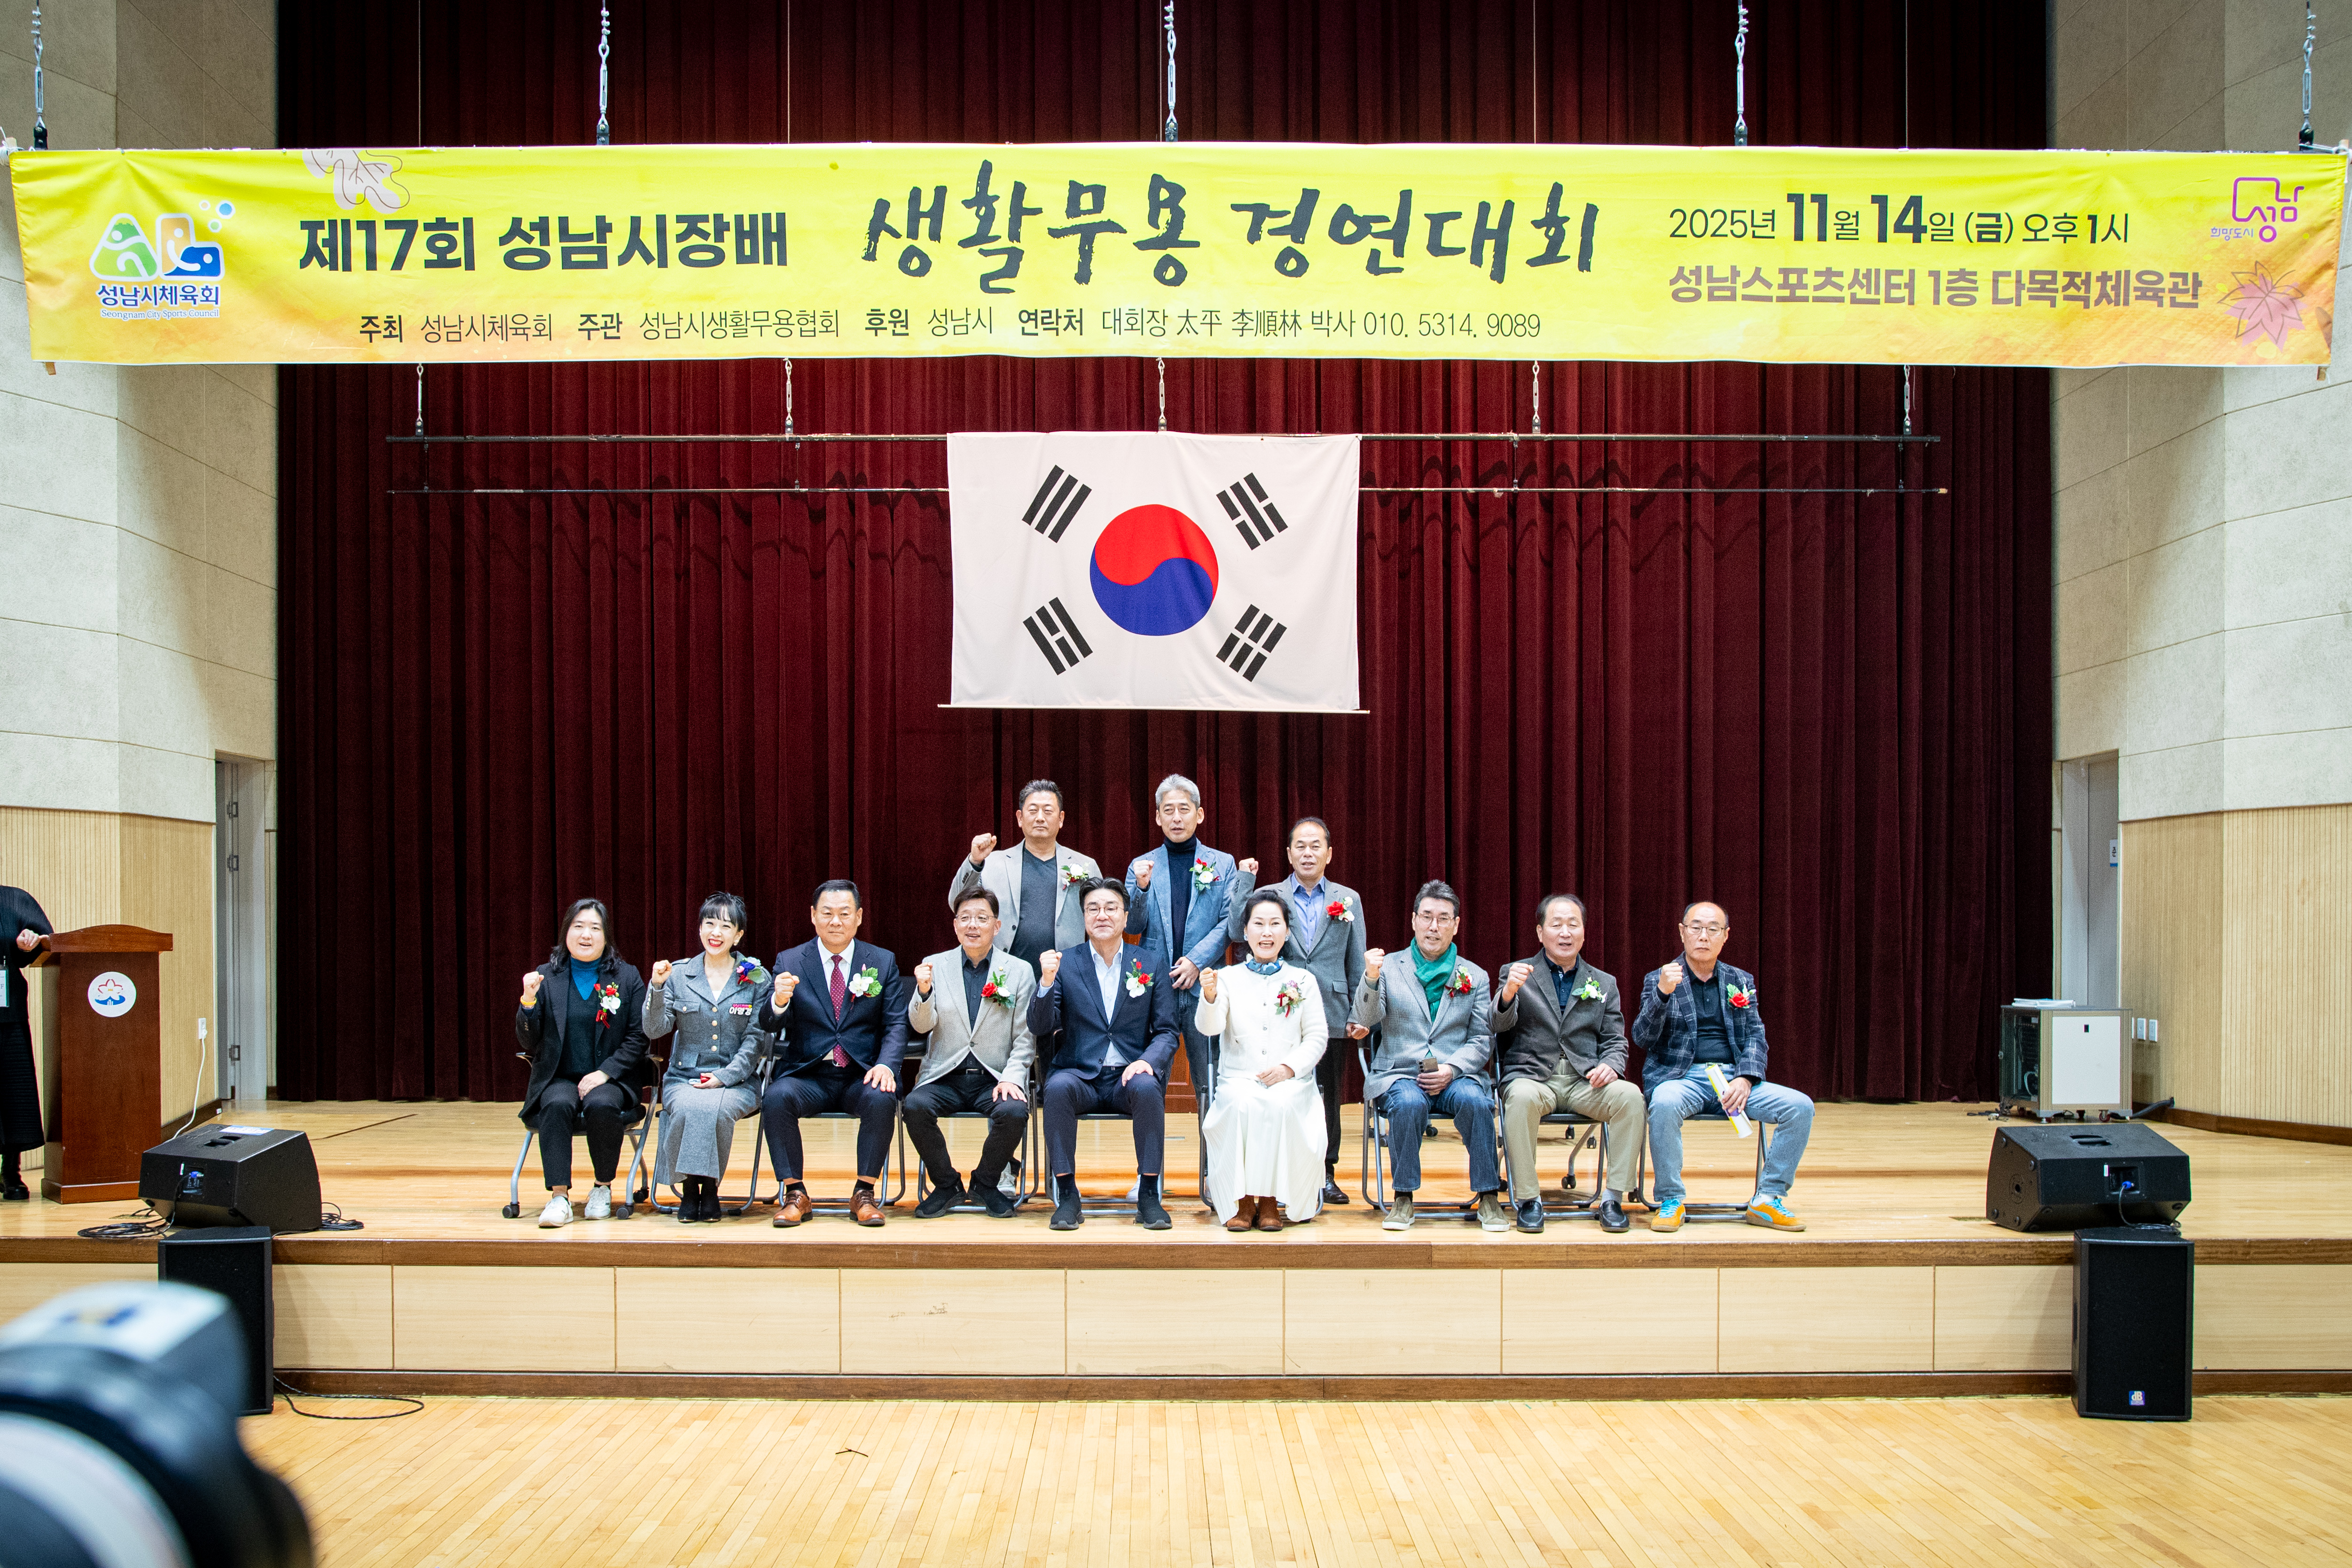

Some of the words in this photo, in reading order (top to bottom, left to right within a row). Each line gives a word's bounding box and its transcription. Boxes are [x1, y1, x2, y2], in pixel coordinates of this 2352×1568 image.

[300, 218, 475, 272] 제17회
[499, 213, 787, 270] 성남시장배
[862, 160, 1200, 294] 생활무용
[1231, 182, 1599, 284] 경연대회
[1670, 209, 1775, 239] 2025년
[1787, 193, 1859, 242] 11월
[1871, 195, 1953, 243] 14일
[1965, 212, 2013, 243] (금)
[2023, 213, 2078, 243] 오후
[2087, 213, 2128, 243] 1시
[2211, 227, 2253, 241] 희망도시
[98, 285, 219, 306] 성남시체육회
[1670, 265, 1915, 306] 성남스포츠센터
[1928, 268, 1979, 306] 1층
[1992, 269, 2203, 308] 다목적체육관
[102, 309, 145, 320] Seongnam
[147, 311, 161, 319] City
[163, 309, 187, 319] Sports
[360, 315, 403, 343] 주최
[421, 314, 552, 343] 성남시체육회
[578, 313, 622, 340] 주관
[640, 310, 839, 340] 성남시생활무용협회
[865, 309, 909, 336] 후원
[928, 307, 992, 337] 성남시
[1019, 308, 1083, 336] 연락처
[1103, 308, 1168, 337] 대회장
[1176, 309, 1222, 337] 太平
[1231, 309, 1302, 337] 李順林
[1311, 310, 1356, 337] 박사
[1364, 312, 1408, 338] 010.
[1419, 313, 1477, 338] 5314.
[1487, 314, 1540, 337] 9089
[2132, 1391, 2142, 1401] dB
